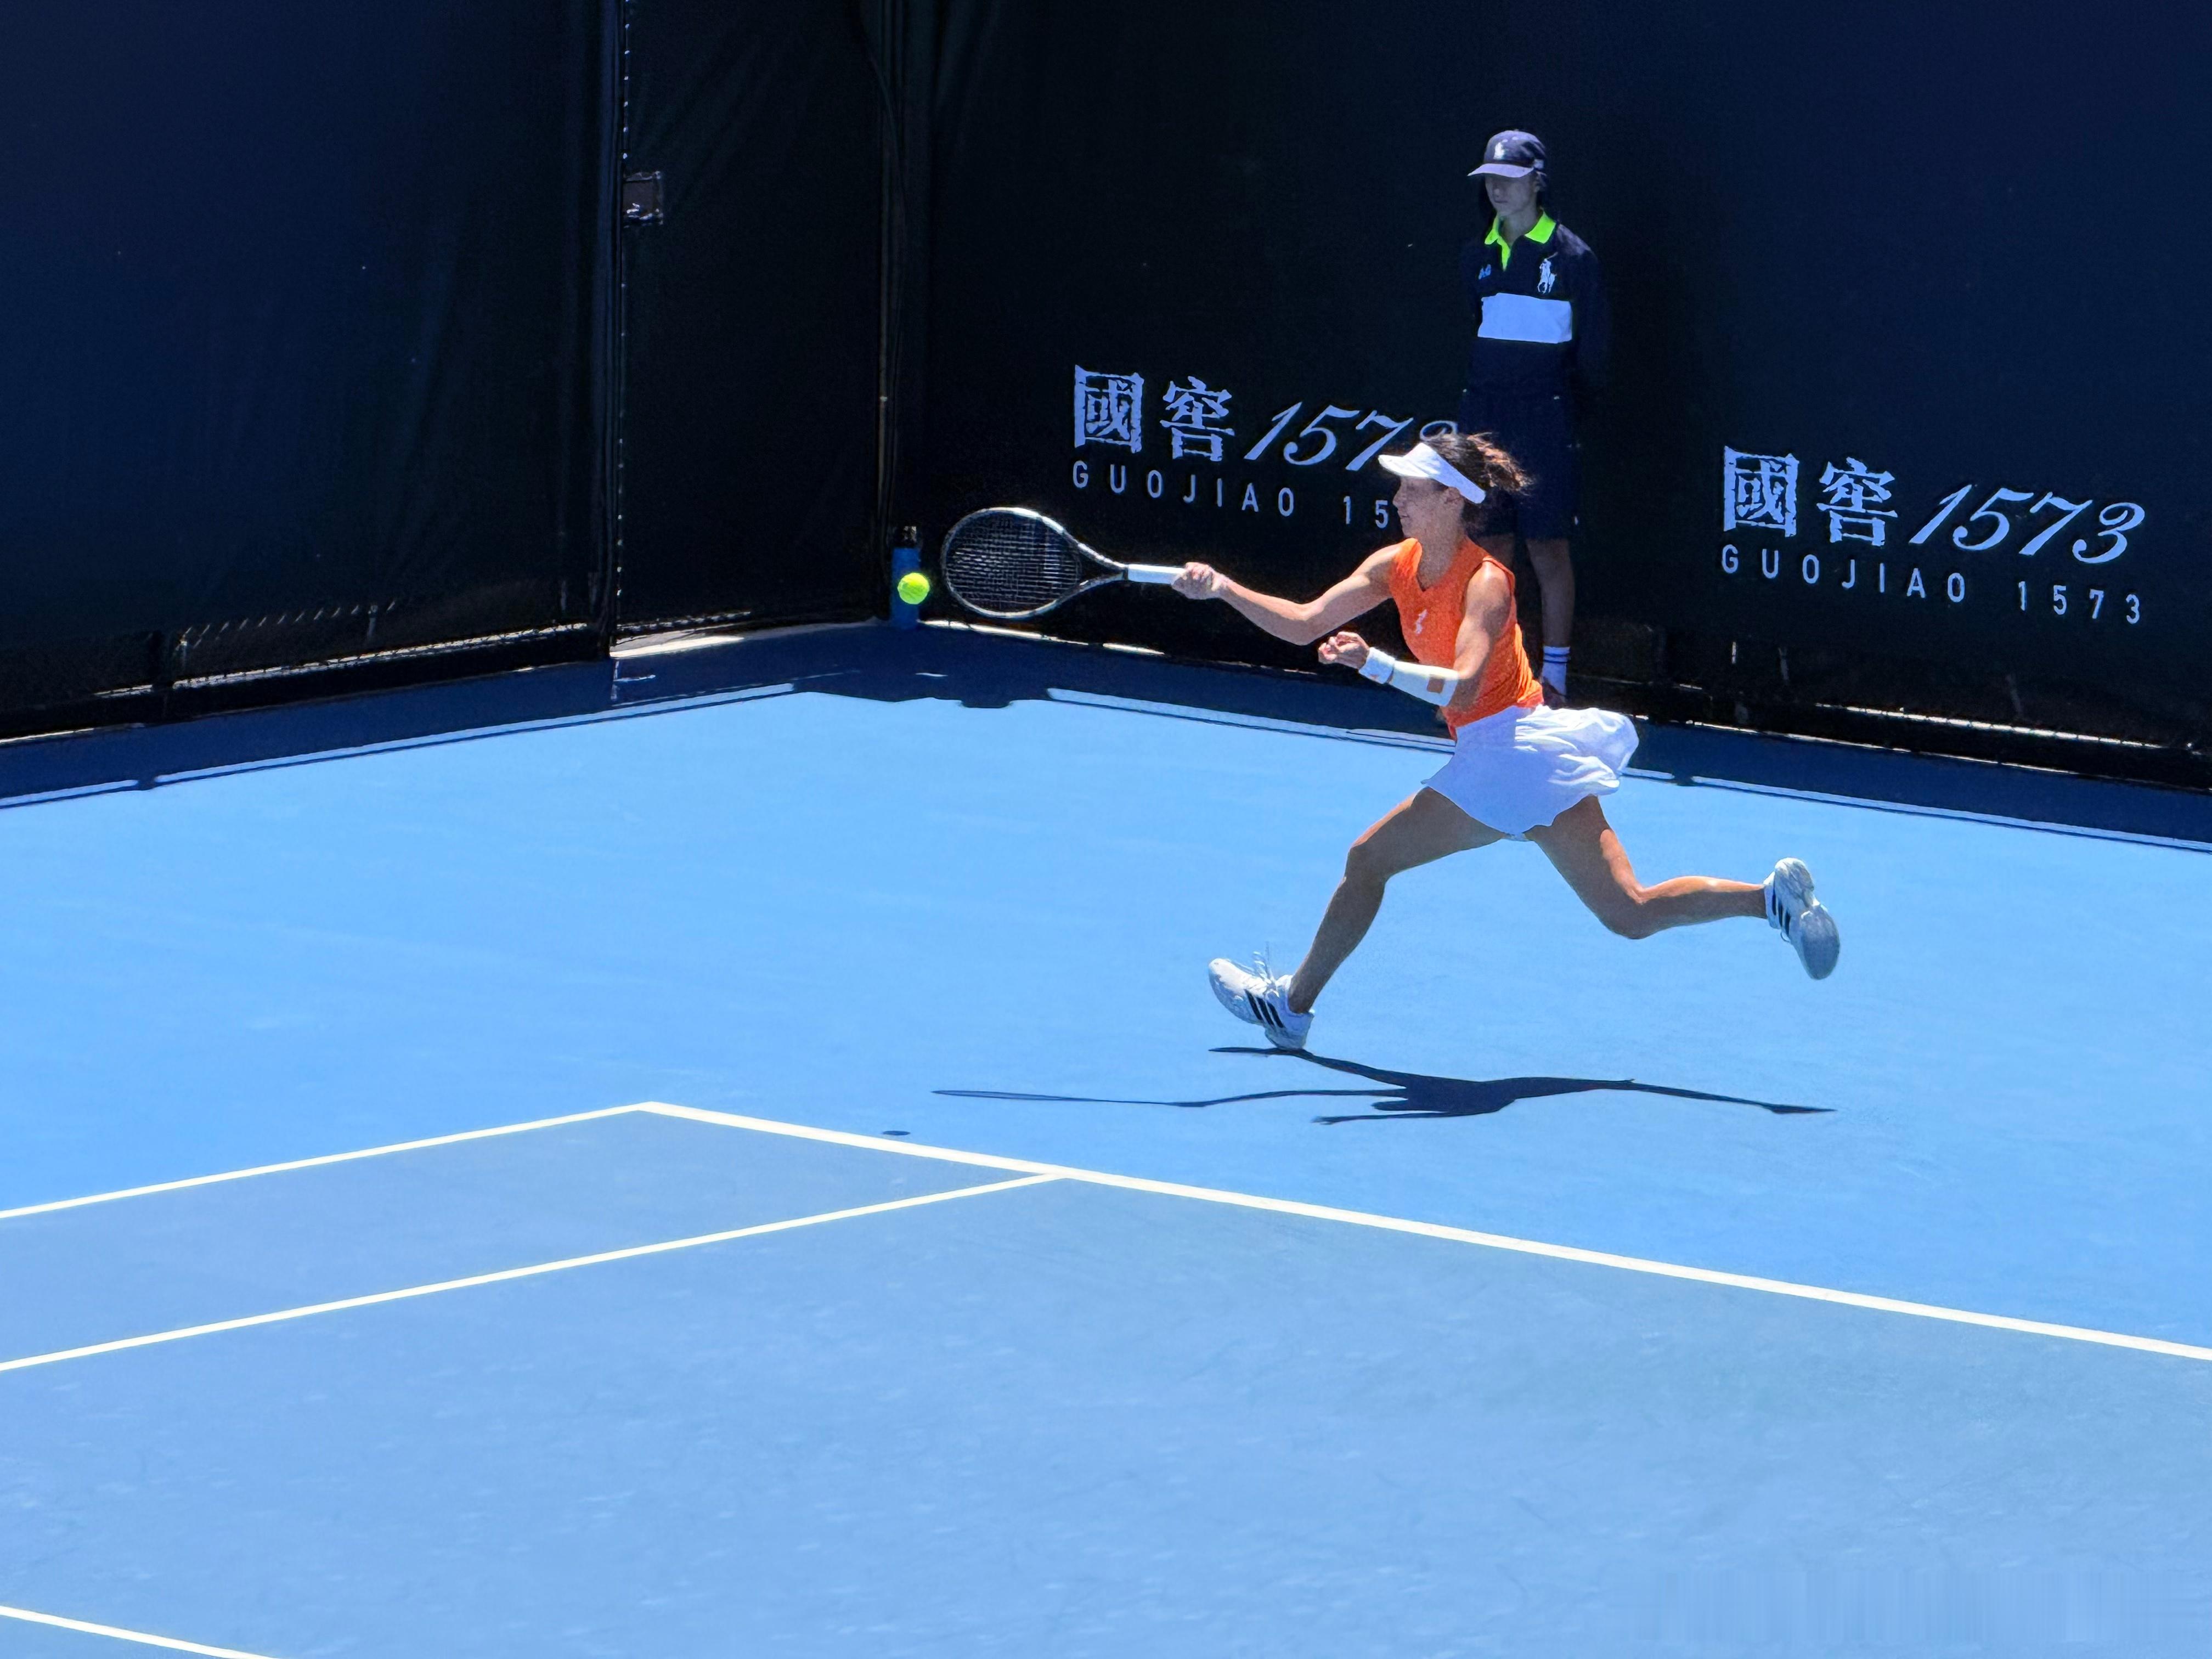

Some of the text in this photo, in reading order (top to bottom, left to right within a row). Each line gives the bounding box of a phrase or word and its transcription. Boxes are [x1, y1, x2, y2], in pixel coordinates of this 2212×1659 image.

[1074, 364, 1235, 462] 國窖
[1073, 460, 1389, 529] GUOJIAO 15
[1723, 445, 2146, 564] 國窖 1573
[1721, 544, 2140, 624] GUOJIAO 1573
